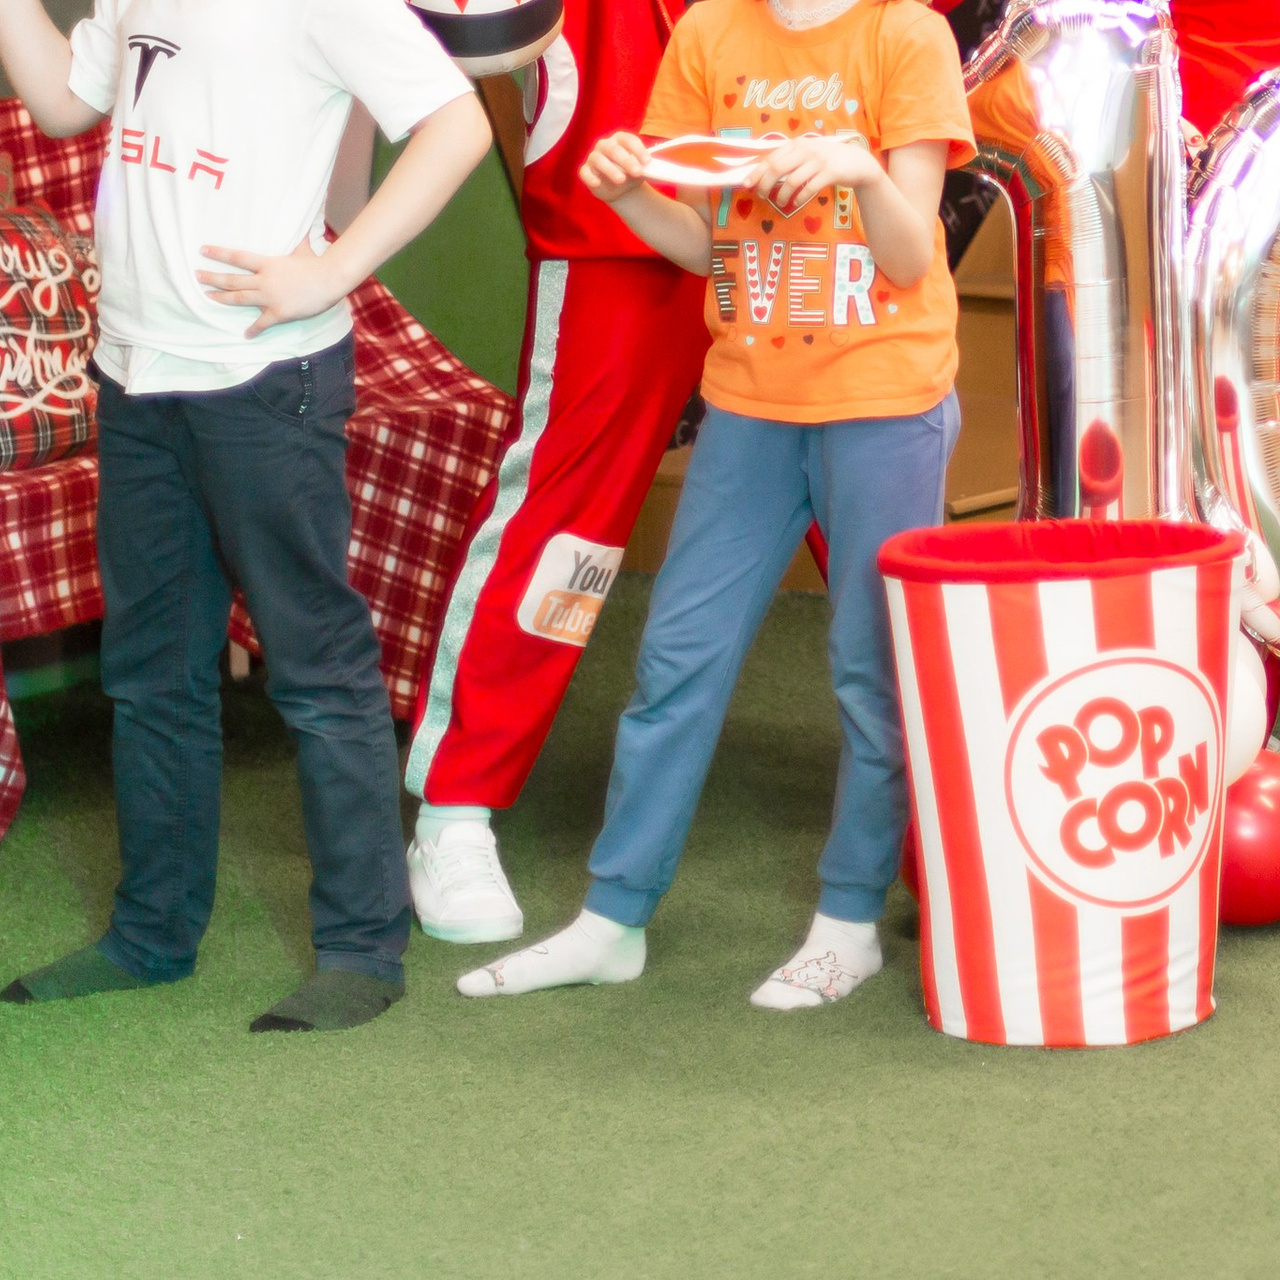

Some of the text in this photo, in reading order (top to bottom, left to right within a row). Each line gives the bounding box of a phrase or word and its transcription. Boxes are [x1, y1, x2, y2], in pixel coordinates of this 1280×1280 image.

[743, 72, 844, 112] never
[567, 550, 612, 596] You
[1035, 695, 1175, 803] POP
[1059, 739, 1210, 871] CORN
